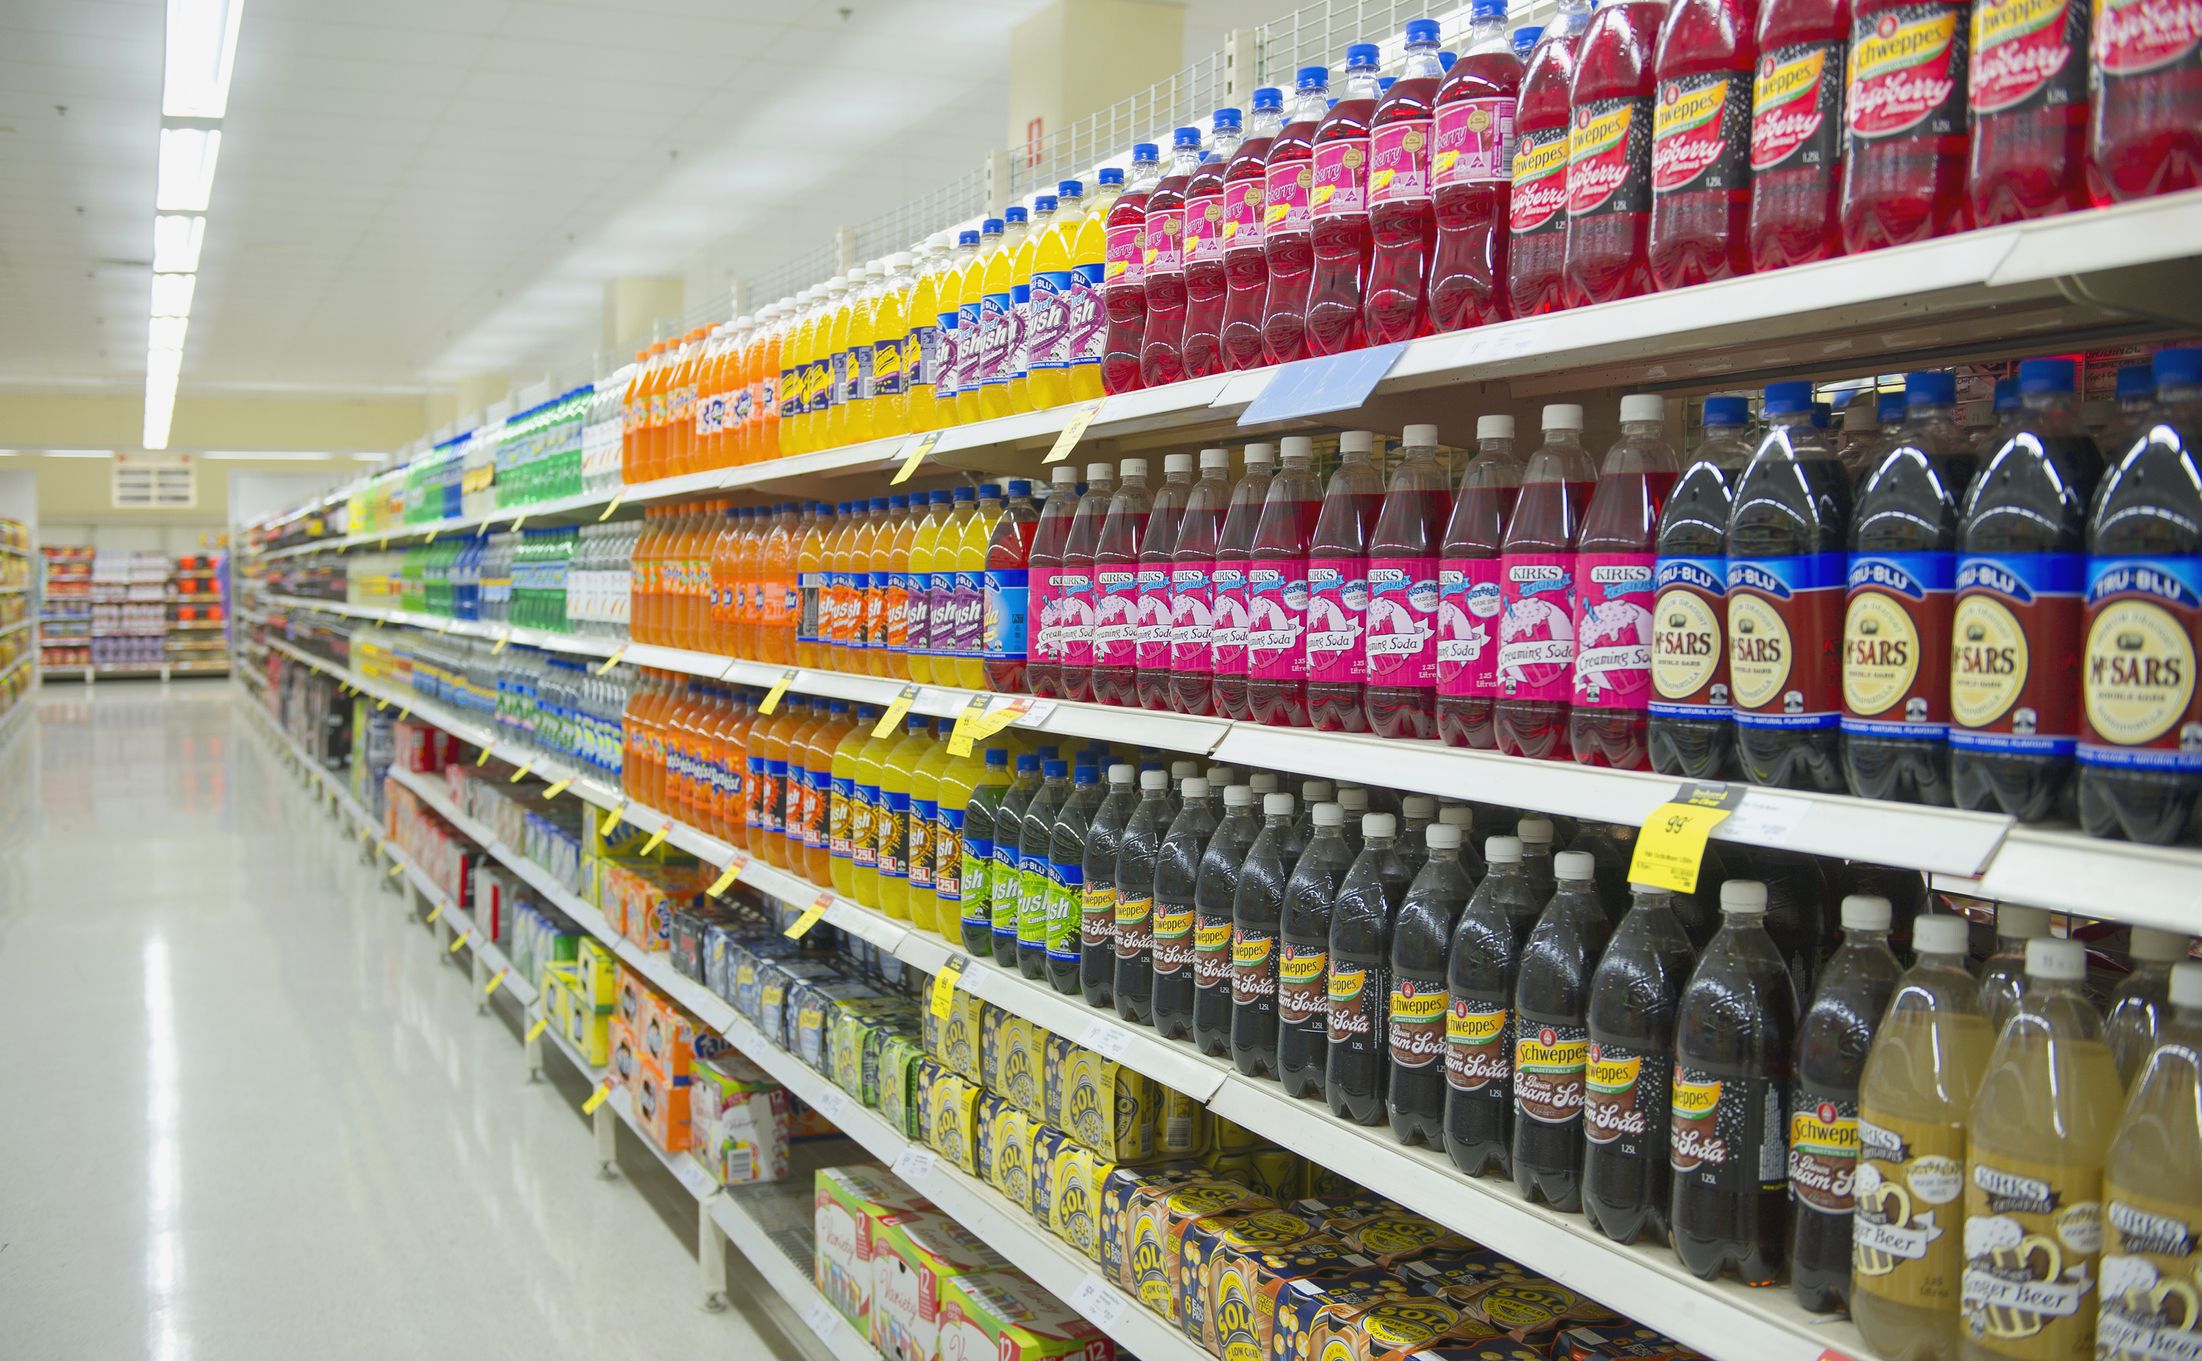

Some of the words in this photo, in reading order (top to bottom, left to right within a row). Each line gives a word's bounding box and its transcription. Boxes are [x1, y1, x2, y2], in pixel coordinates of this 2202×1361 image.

[1101, 573, 1131, 583] KIRKS
[1512, 567, 1558, 580] KIRKS
[1595, 568, 1647, 580] KIRKS
[1658, 564, 1712, 587] TRU-BLU
[1267, 634, 1291, 646] Soda
[1326, 634, 1349, 646] Soda
[1390, 638, 1418, 650] Soda
[1451, 643, 1474, 656] Soda
[1578, 651, 1629, 671] Creaming
[1241, 974, 1275, 994] Soda
[1291, 991, 1328, 1012] Soda
[1334, 1010, 1370, 1033] Soda
[1352, 1042, 1363, 1050] 1.25L
[1520, 1043, 1588, 1064] Schweppes
[1464, 1054, 1510, 1078] Soda
[1514, 1071, 1552, 1103] Cream
[1526, 1075, 1551, 1090] Brown
[1490, 1090, 1503, 1098] 1.25L
[1596, 1104, 1645, 1134] Soda
[1622, 1144, 1637, 1155] 1.25L
[1679, 1131, 1727, 1162] Soda
[1701, 1173, 1717, 1185] 1.25L
[1976, 1170, 2041, 1199] KIRKS
[1061, 1189, 1092, 1225] SOLO
[1874, 1226, 1916, 1251] Beer
[1104, 1240, 1110, 1258] 6
[1134, 1245, 1169, 1281] SOLO
[920, 1267, 931, 1295] 12
[1185, 1295, 1191, 1315] 6
[1495, 1288, 1569, 1315] SOLO
[1500, 1299, 1521, 1309] LOW
[2016, 1283, 2068, 1309] Beer
[1218, 1302, 1259, 1341] SOLO
[1378, 1306, 1451, 1333] SOLO
[1382, 1317, 1403, 1328] LOW
[1083, 1340, 1107, 1361] 12
